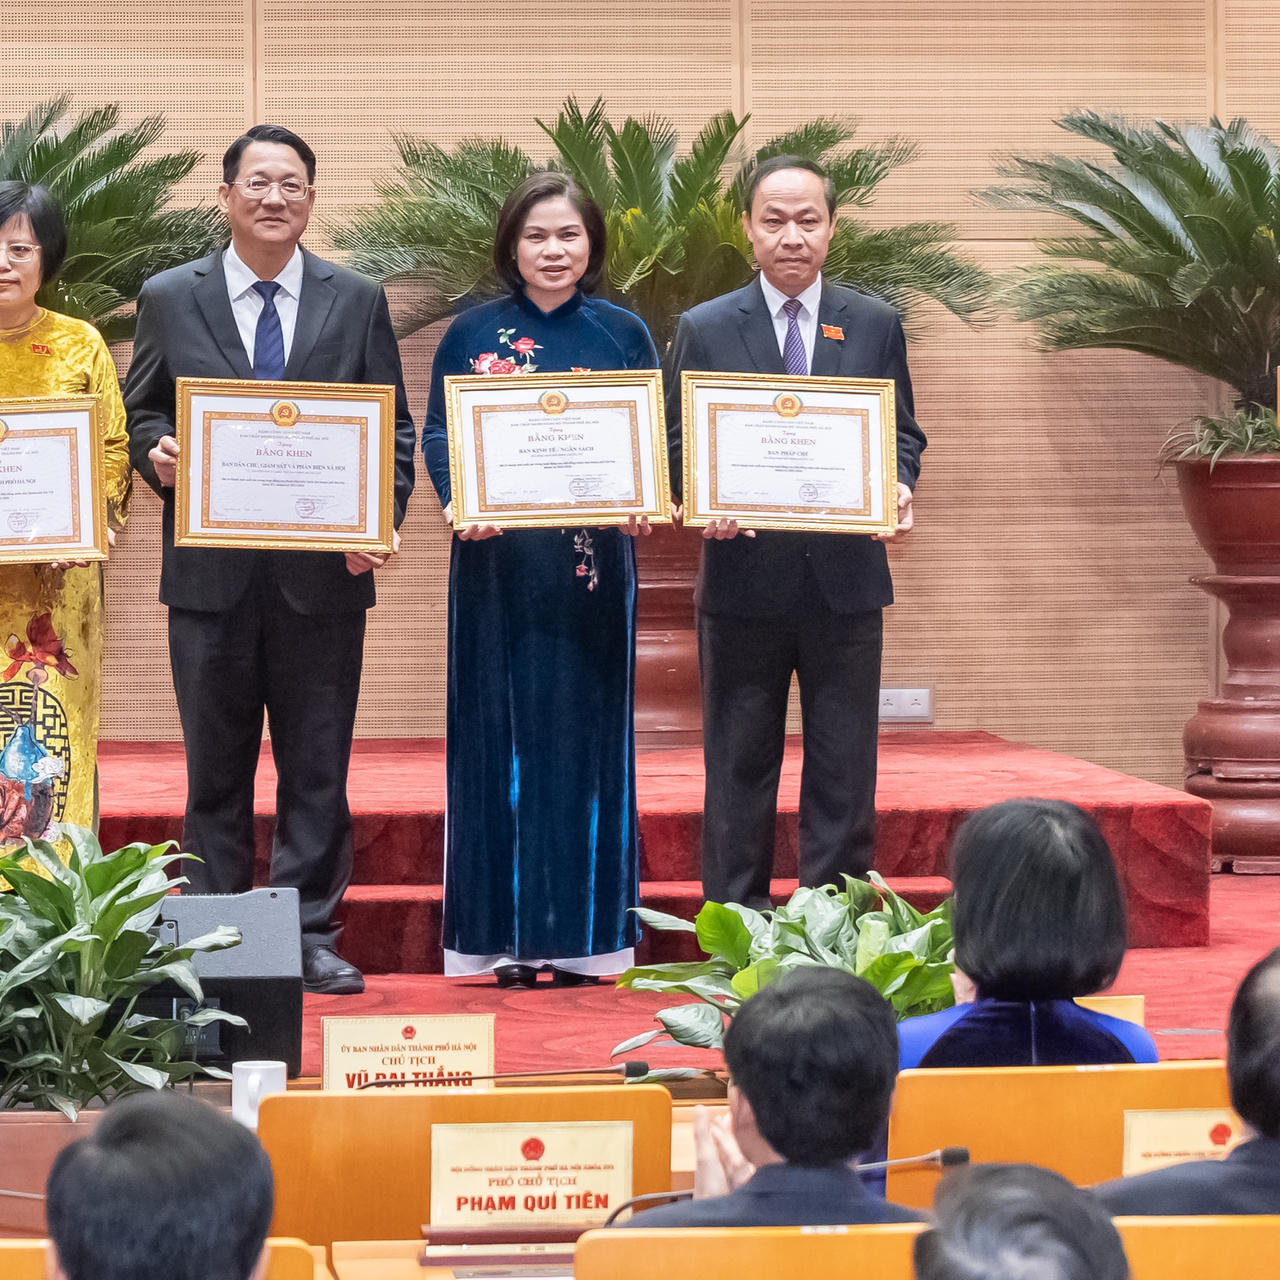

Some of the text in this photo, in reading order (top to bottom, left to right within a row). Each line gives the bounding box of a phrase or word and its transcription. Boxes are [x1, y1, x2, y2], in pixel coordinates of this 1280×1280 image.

[369, 1044, 388, 1052] NHÂN
[391, 1044, 406, 1052] DÂN
[408, 1044, 433, 1052] THÀNH
[435, 1042, 450, 1051] PHỐ
[452, 1043, 461, 1051] HÀ
[463, 1043, 476, 1052] NỘI
[382, 1054, 436, 1066] CHỦ TỊCH
[345, 1069, 369, 1088] VŨ
[412, 1065, 473, 1087] THẮNG
[518, 1173, 542, 1186] CHỦ
[547, 1176, 576, 1187] TỊCH
[456, 1195, 516, 1215] PHẠM
[524, 1190, 556, 1212] QUÍ
